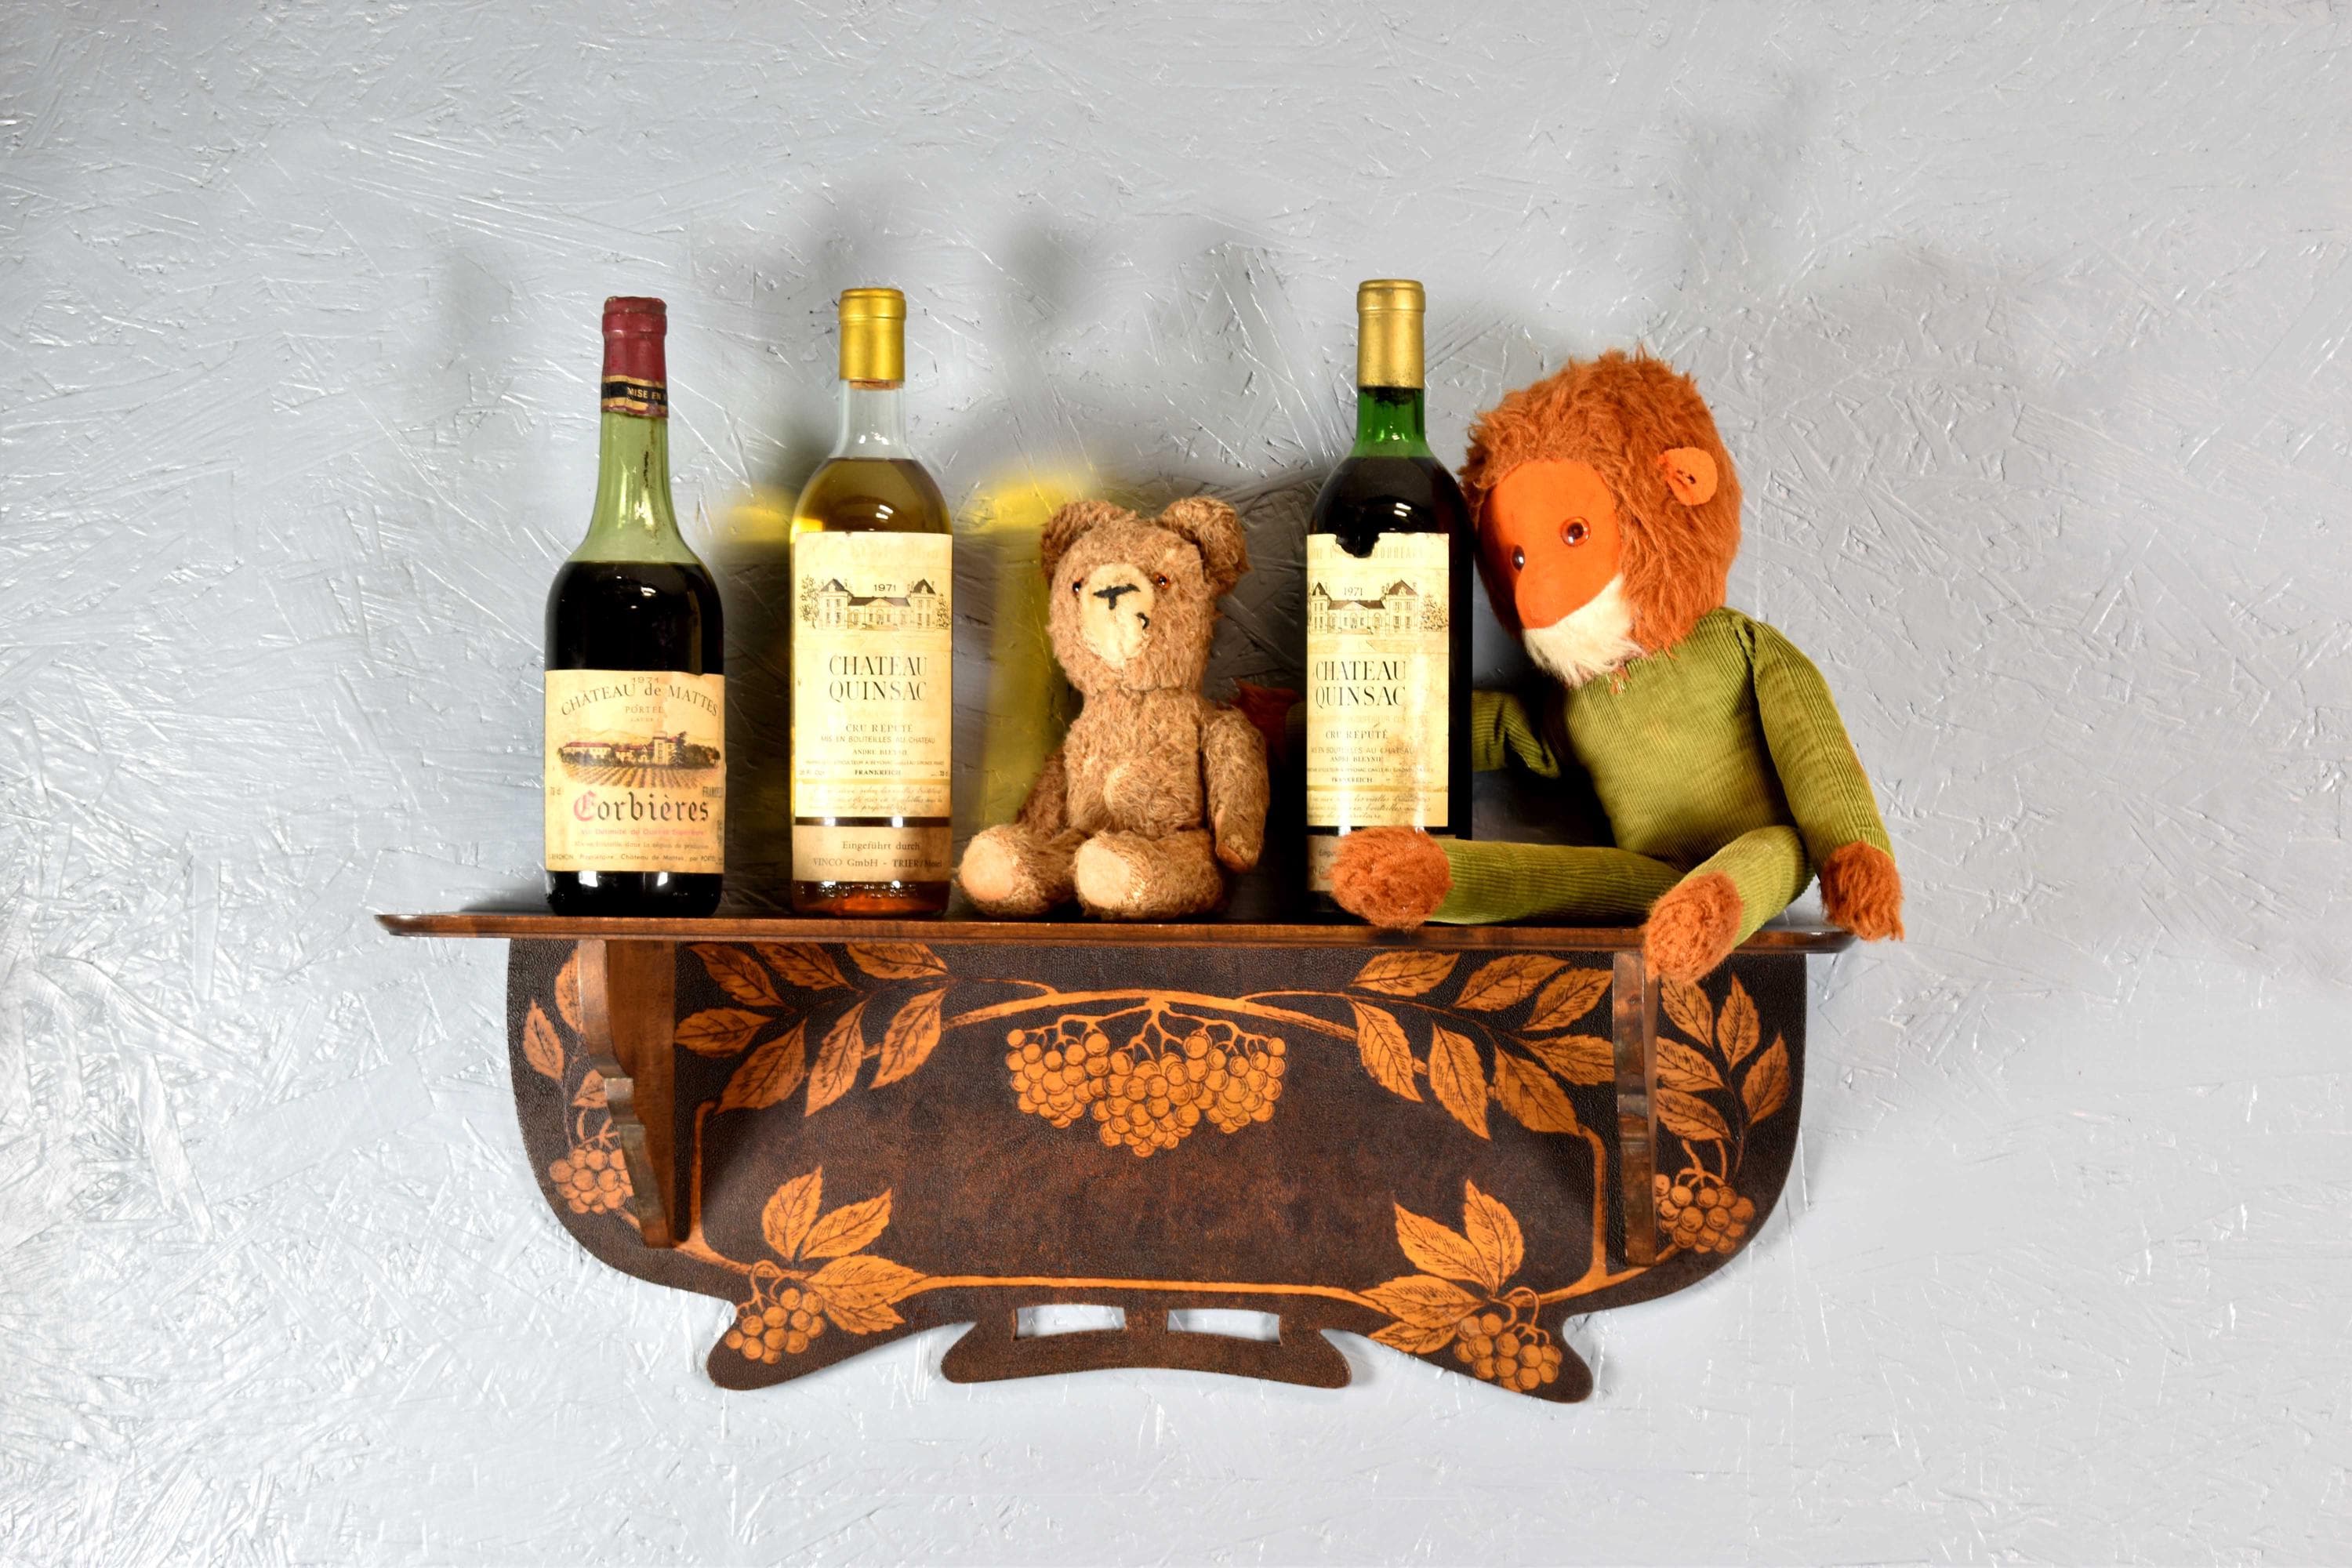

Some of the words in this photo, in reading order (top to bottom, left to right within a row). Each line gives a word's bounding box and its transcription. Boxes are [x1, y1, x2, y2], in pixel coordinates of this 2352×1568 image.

[1343, 587, 1363, 596] 1971
[829, 655, 927, 676] CHATEAU
[1316, 661, 1406, 681] CHATEAU
[644, 683, 662, 696] de
[669, 684, 717, 717] MATTES
[829, 681, 927, 703] QUINSAC
[1316, 686, 1406, 709] QUINSAC
[573, 789, 709, 822] Corbières
[842, 840, 891, 851] Eingeführt
[895, 841, 920, 851] durch
[813, 858, 843, 867] VINCO
[847, 858, 879, 867] GmbH
